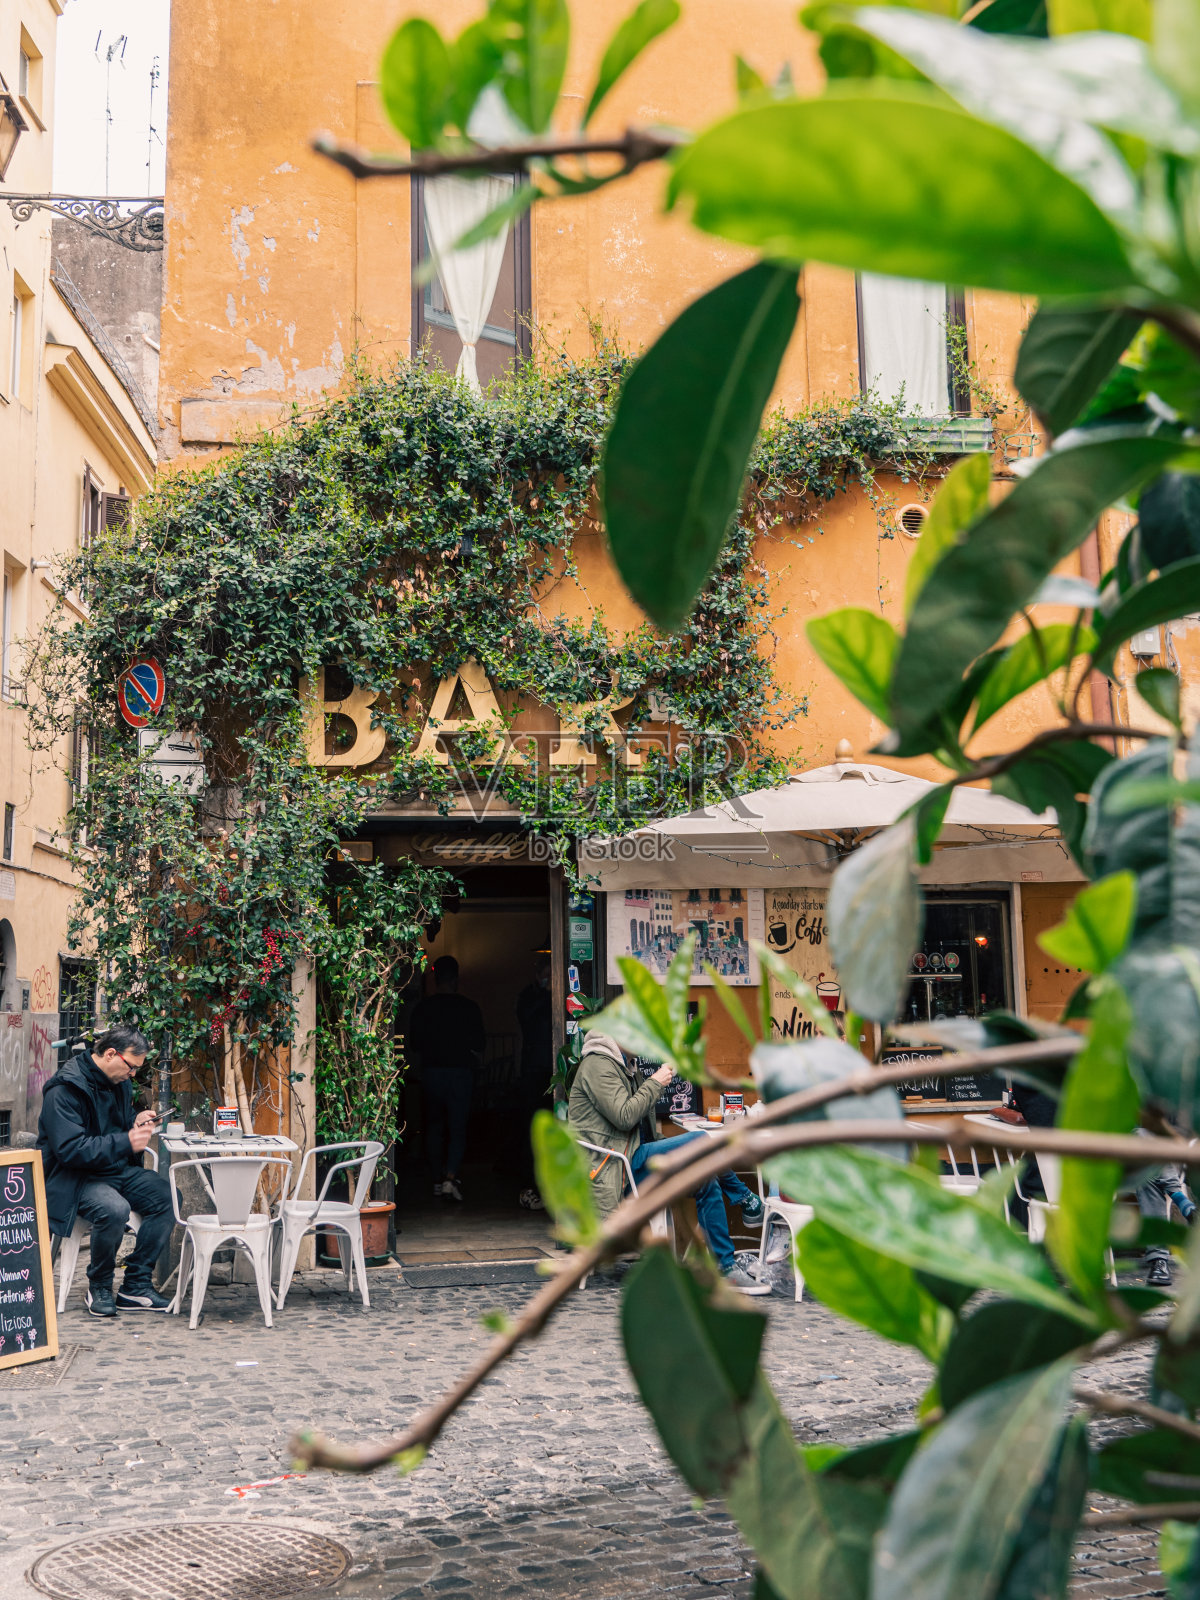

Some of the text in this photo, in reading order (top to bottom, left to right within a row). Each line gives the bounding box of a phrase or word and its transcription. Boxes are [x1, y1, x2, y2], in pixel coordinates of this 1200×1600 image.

[287, 655, 642, 767] BAR
[777, 898, 790, 912] good
[790, 898, 800, 911] day
[801, 898, 819, 910] starts
[795, 917, 829, 946] Coffe
[774, 990, 791, 999] ends
[769, 1006, 820, 1038] Win
[4, 1167, 26, 1203] 5
